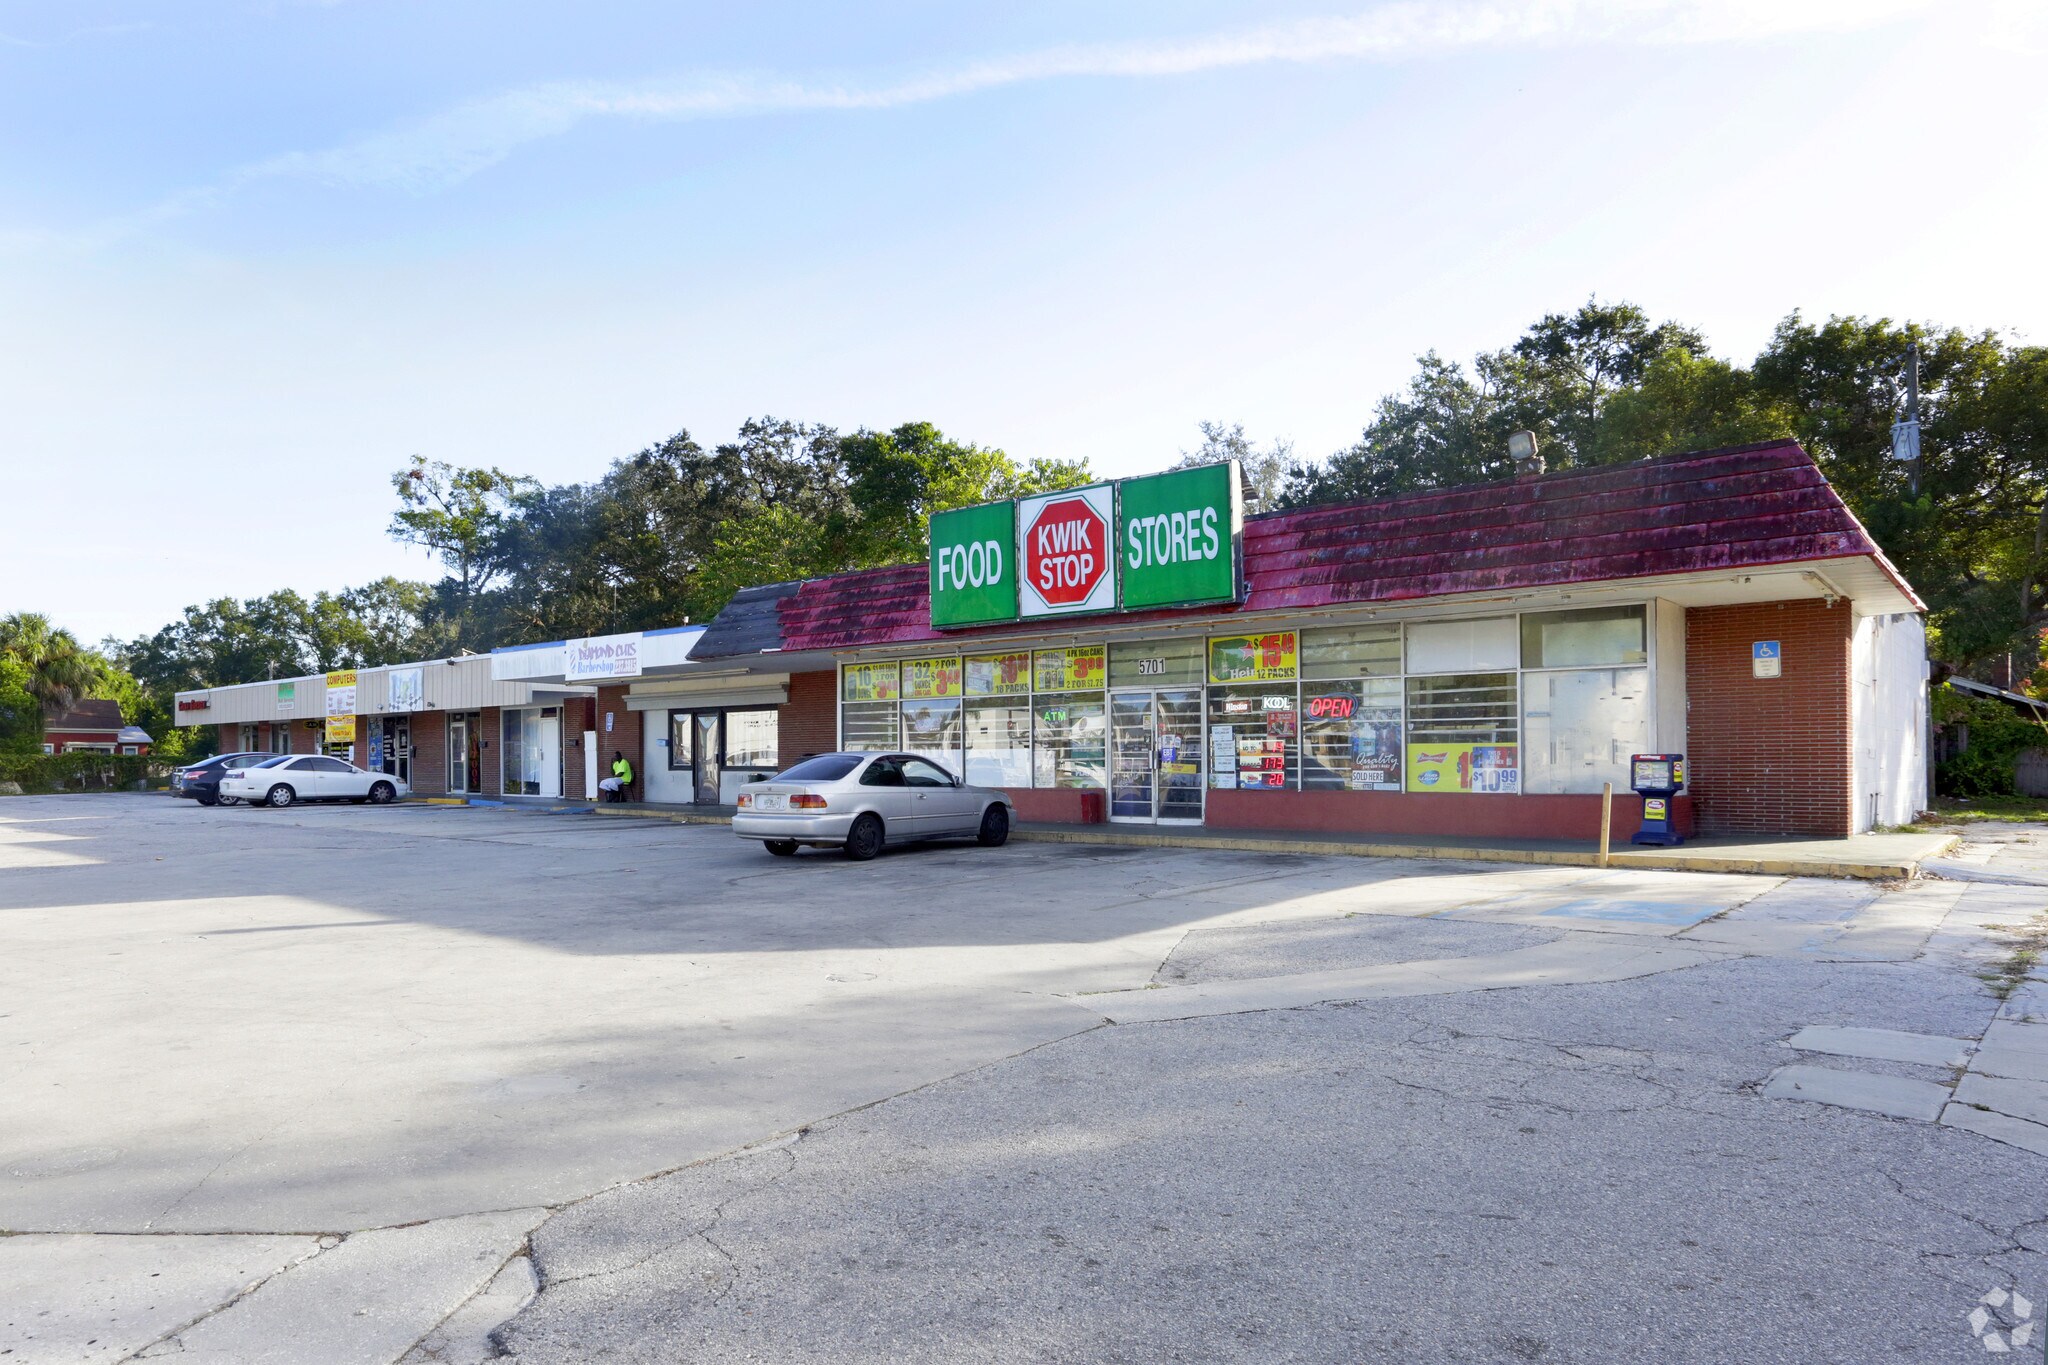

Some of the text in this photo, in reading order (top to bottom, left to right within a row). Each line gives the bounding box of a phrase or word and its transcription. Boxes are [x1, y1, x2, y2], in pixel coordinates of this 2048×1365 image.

[1038, 518, 1092, 556] KWIK
[1128, 506, 1219, 570] STORES
[938, 540, 1002, 592] FOOD
[1039, 553, 1094, 590] STOP
[578, 642, 637, 661] DIAMOND CUTS
[1090, 648, 1104, 657] CANS
[578, 660, 614, 675] Barbershop
[915, 661, 931, 679] 32
[941, 659, 957, 669] FOR
[1139, 659, 1165, 674] 5701
[327, 673, 356, 686] COMPUTERS
[857, 665, 872, 687] 16
[1257, 667, 1295, 679] 12 PACKS
[1006, 683, 1029, 693] PACKS
[1072, 680, 1087, 688] FOR
[1226, 702, 1248, 711] Winston
[1263, 697, 1291, 709] KOOL
[1310, 698, 1353, 717] OPEN
[1044, 711, 1066, 721] ATM
[1356, 752, 1399, 771] Quality
[1353, 771, 1384, 781] SOLD HERE
